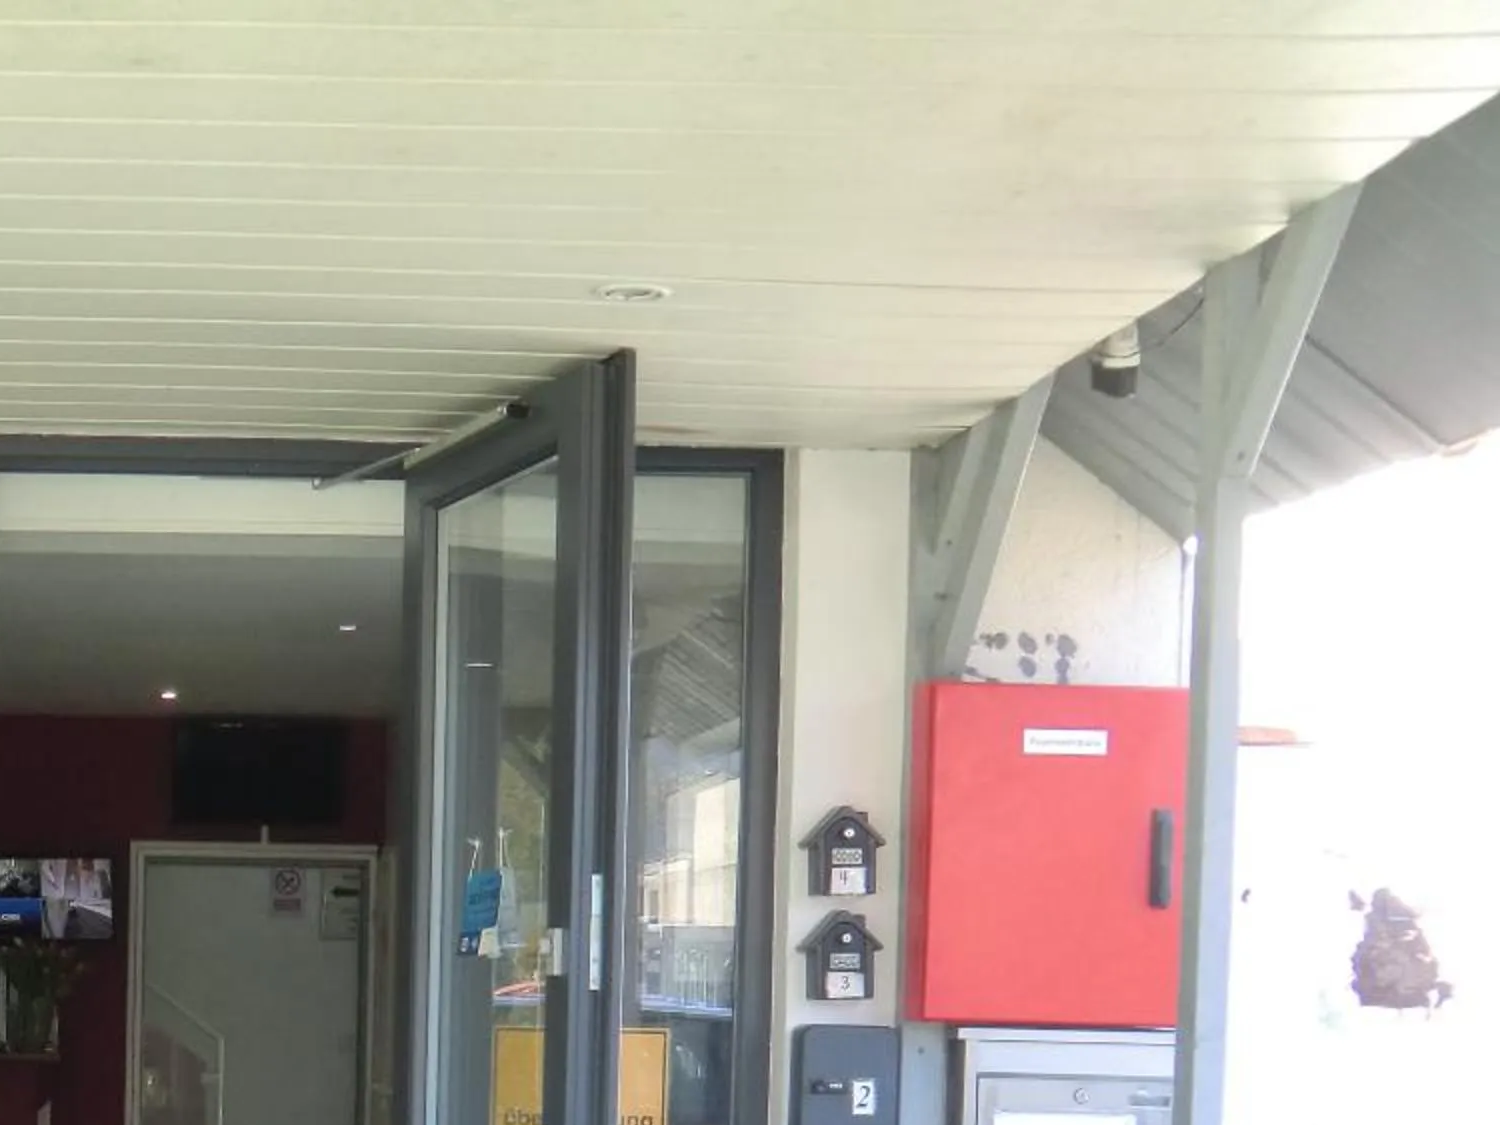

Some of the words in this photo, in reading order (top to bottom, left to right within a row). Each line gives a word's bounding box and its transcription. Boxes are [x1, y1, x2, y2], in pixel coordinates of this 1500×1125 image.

[839, 870, 848, 885] 4
[840, 975, 851, 991] 3
[856, 1085, 871, 1108] 2
